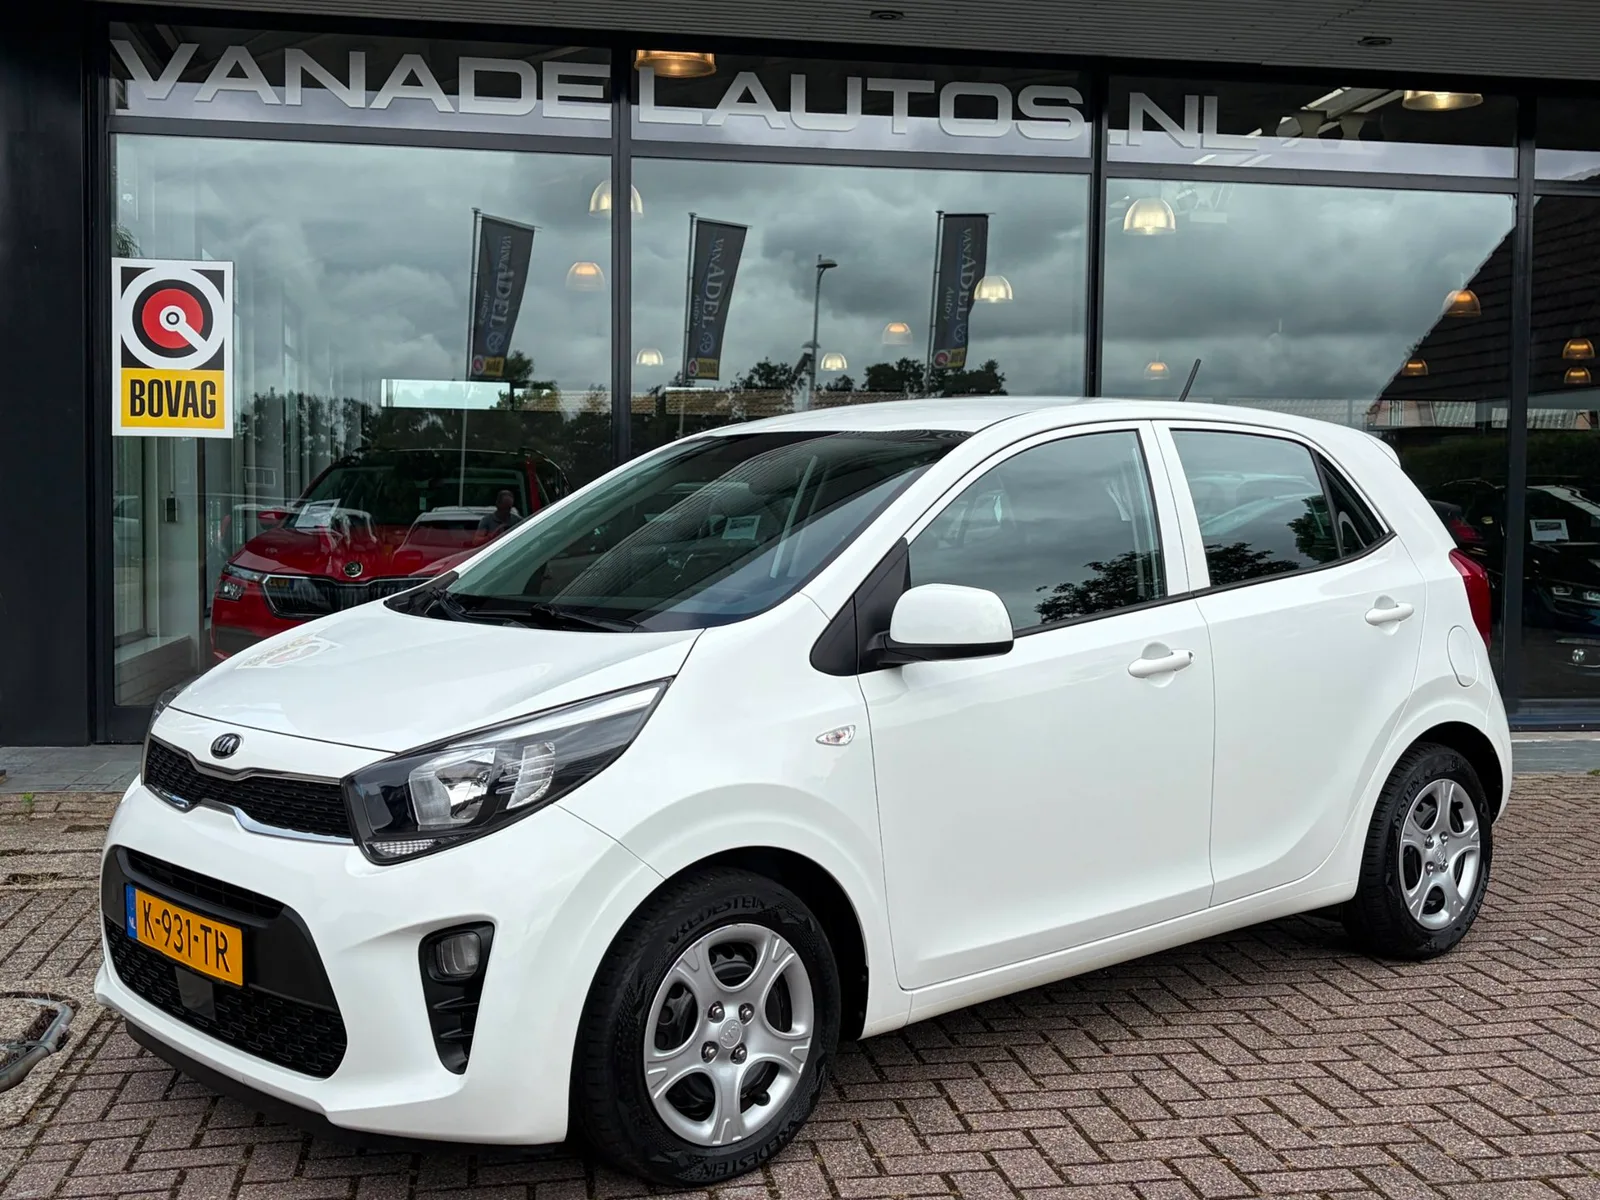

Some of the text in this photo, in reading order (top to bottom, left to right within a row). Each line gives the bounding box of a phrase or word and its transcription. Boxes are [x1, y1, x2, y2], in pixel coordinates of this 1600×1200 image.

[130, 378, 216, 419] BOVAG
[211, 736, 236, 754] KIA
[143, 899, 231, 973] K-931-TR
